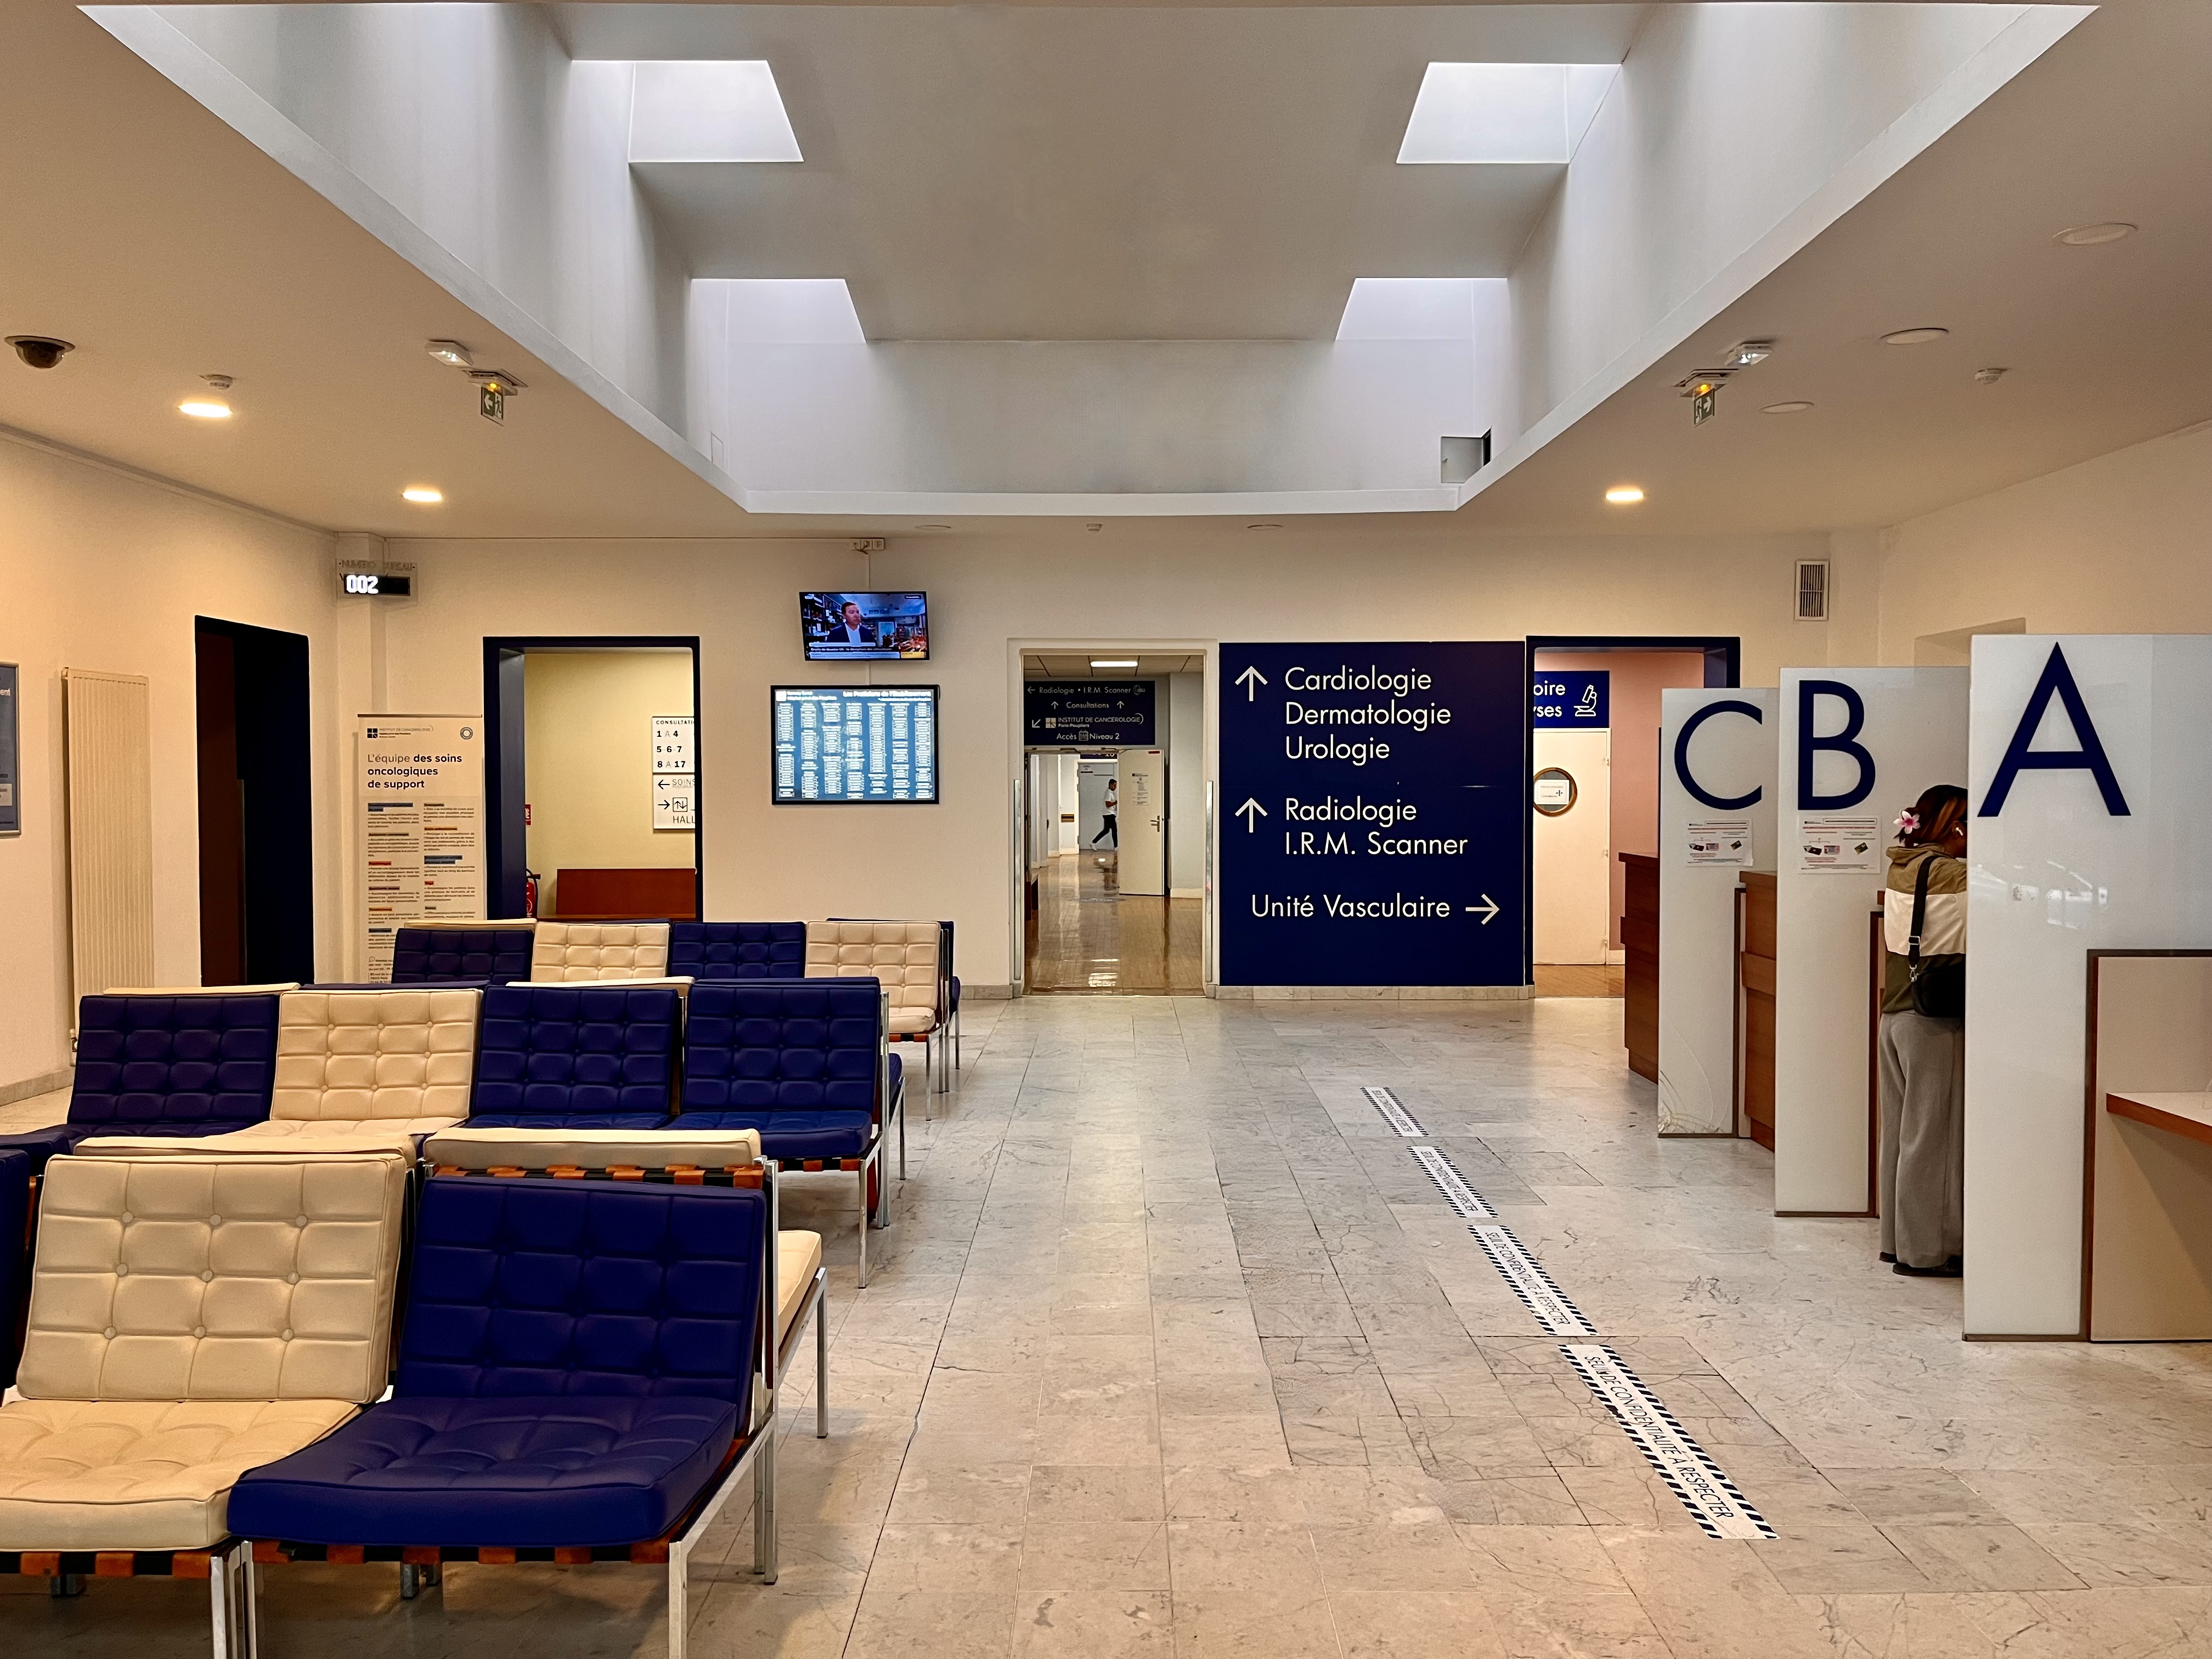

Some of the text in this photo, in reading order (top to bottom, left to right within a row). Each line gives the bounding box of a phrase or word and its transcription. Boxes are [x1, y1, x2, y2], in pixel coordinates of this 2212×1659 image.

[346, 574, 379, 594] 002
[1039, 686, 1075, 695] Radiologie
[1285, 665, 1431, 697] Cardiologie
[1285, 699, 1451, 731] Dermatologie
[1977, 642, 2131, 817] A
[368, 754, 462, 764] L'équipe des soins
[1286, 734, 1389, 765] Urologie
[1674, 701, 1762, 810] C
[1798, 680, 1875, 810] B
[368, 767, 438, 777] oncologiques
[384, 780, 425, 790] support
[1285, 795, 1417, 828] Radiologie
[1286, 832, 1468, 854] I.R.M. Scanner
[1252, 893, 1449, 917] Unité Vasculaire
[1599, 1375, 1622, 1385] DE
[1676, 1467, 1734, 1518] RESPECTER
